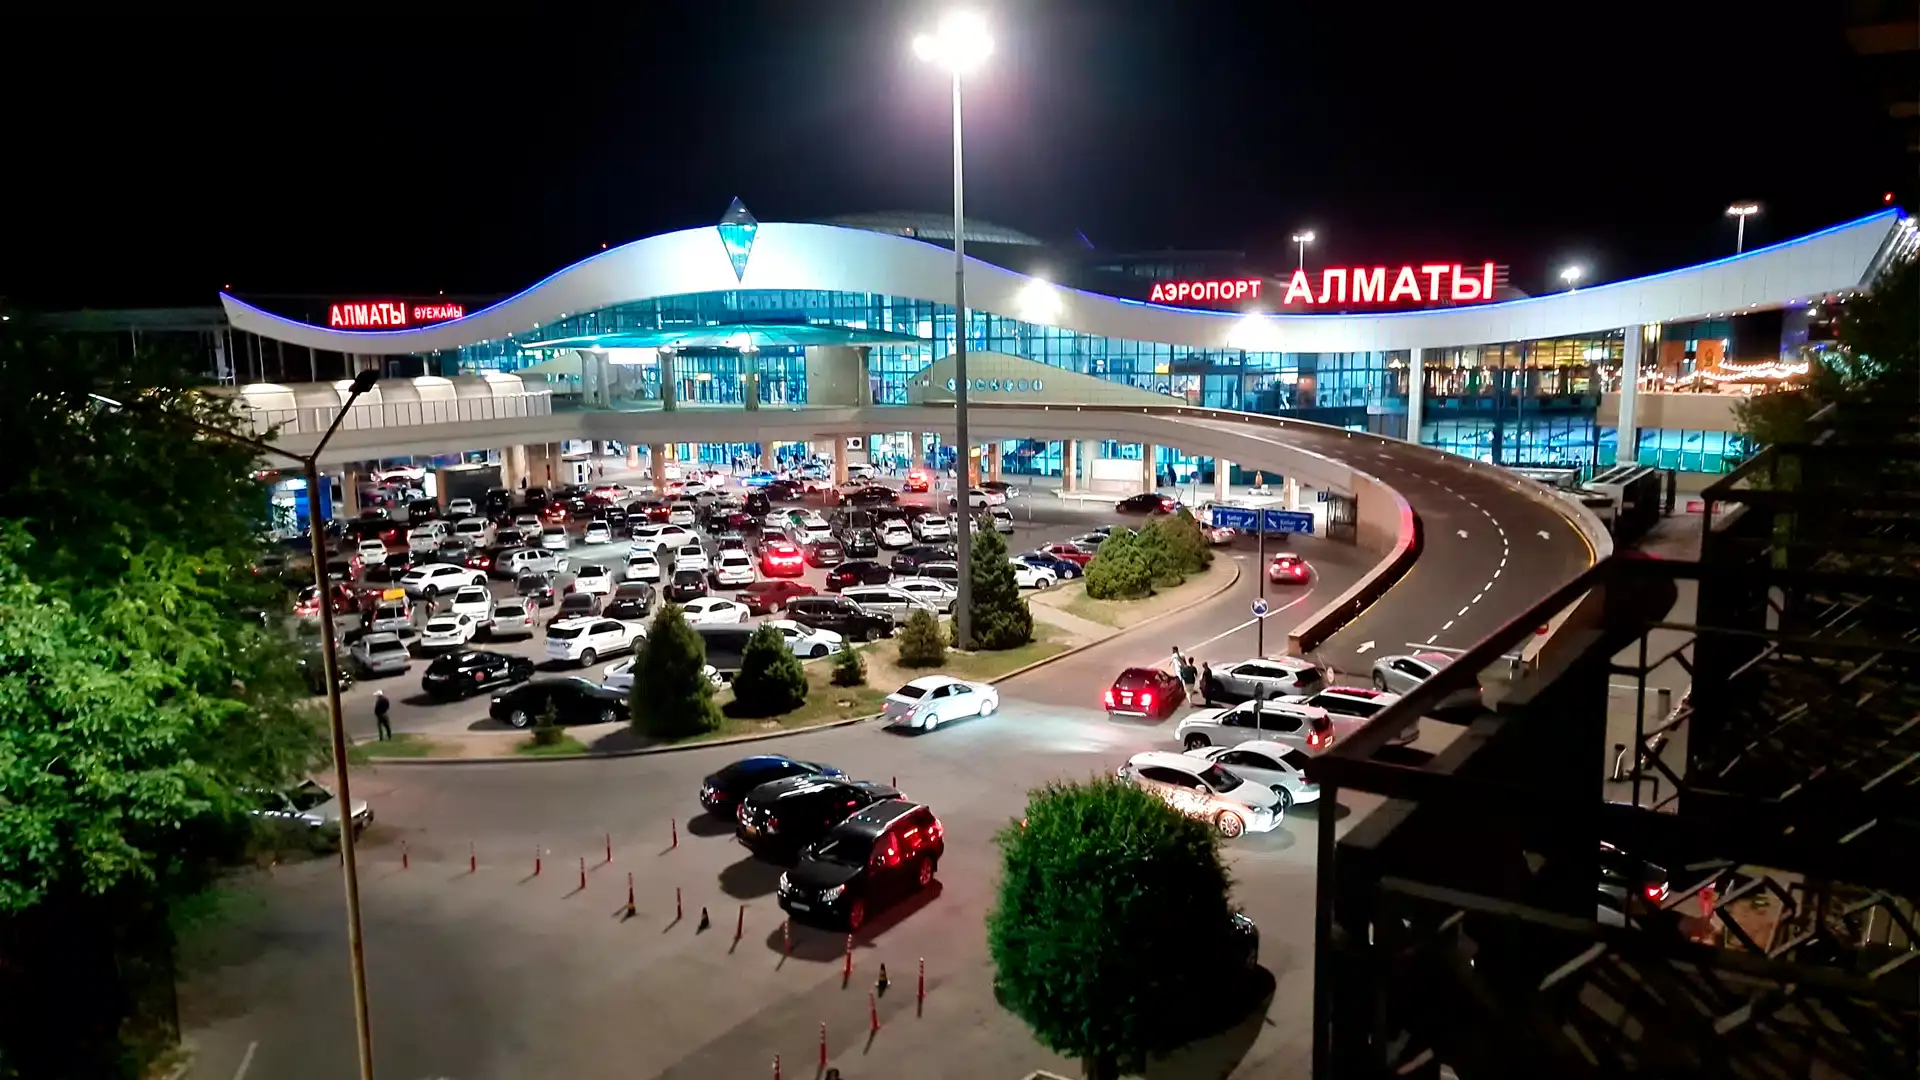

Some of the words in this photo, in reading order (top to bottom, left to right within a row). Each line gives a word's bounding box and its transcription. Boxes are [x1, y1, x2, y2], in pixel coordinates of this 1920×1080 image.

[1151, 280, 1261, 301] АЭРОПОРТ
[1284, 263, 1494, 304] АЛМАТЫ
[331, 302, 406, 326] АЛМАТЫ
[414, 304, 463, 319] ӘУЕЖАЙЫ
[1216, 513, 1222, 525] 1
[1300, 520, 1308, 532] 2
